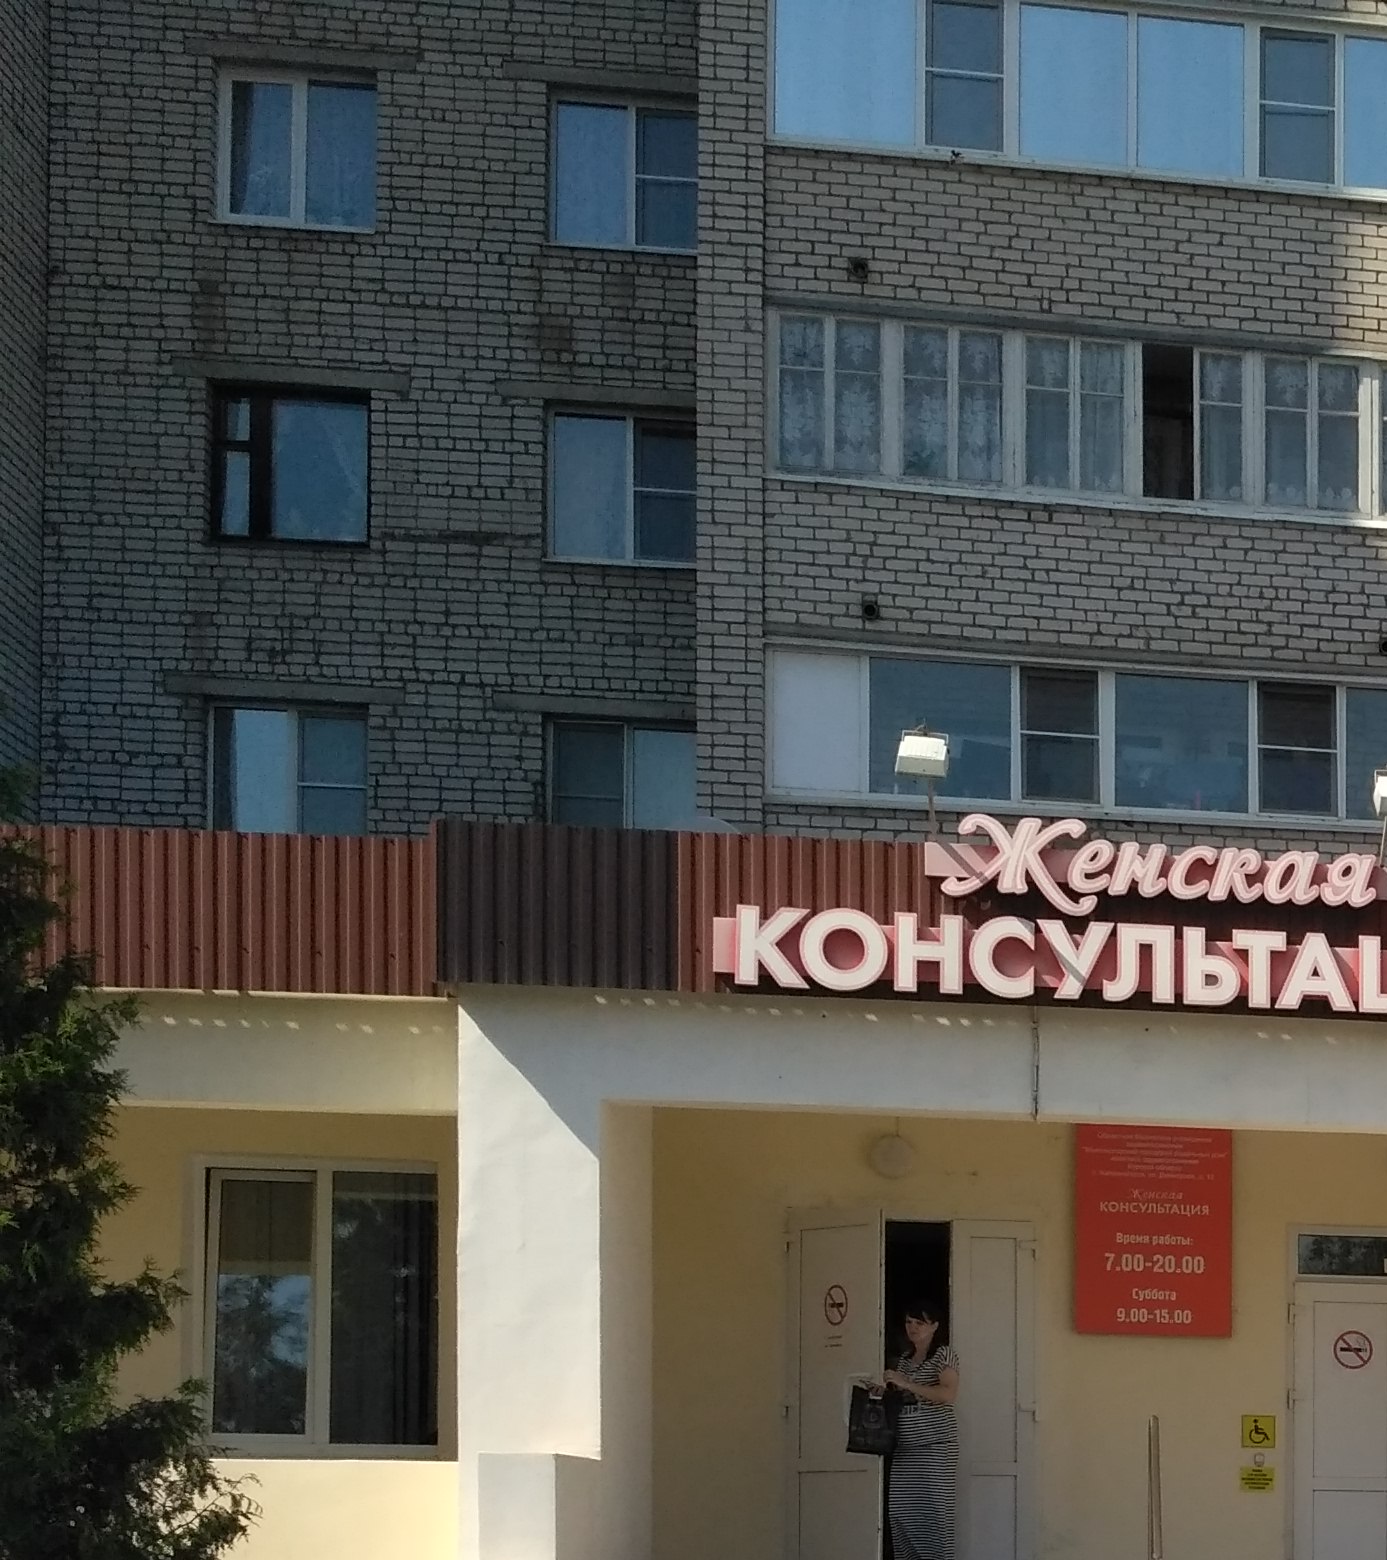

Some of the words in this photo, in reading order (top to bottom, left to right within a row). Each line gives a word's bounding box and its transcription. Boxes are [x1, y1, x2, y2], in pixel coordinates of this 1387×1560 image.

[941, 813, 1378, 915] Женская
[1130, 1188, 1184, 1200] Женская
[1100, 1201, 1210, 1216] КОНСУЛЬТАЦИЯ
[1116, 1232, 1150, 1244] Время
[1152, 1235, 1194, 1245] работы:
[1104, 1252, 1205, 1274] 7.00-20.00
[1132, 1288, 1176, 1301] Суббота
[1116, 1308, 1192, 1324] 9.00-15.00
